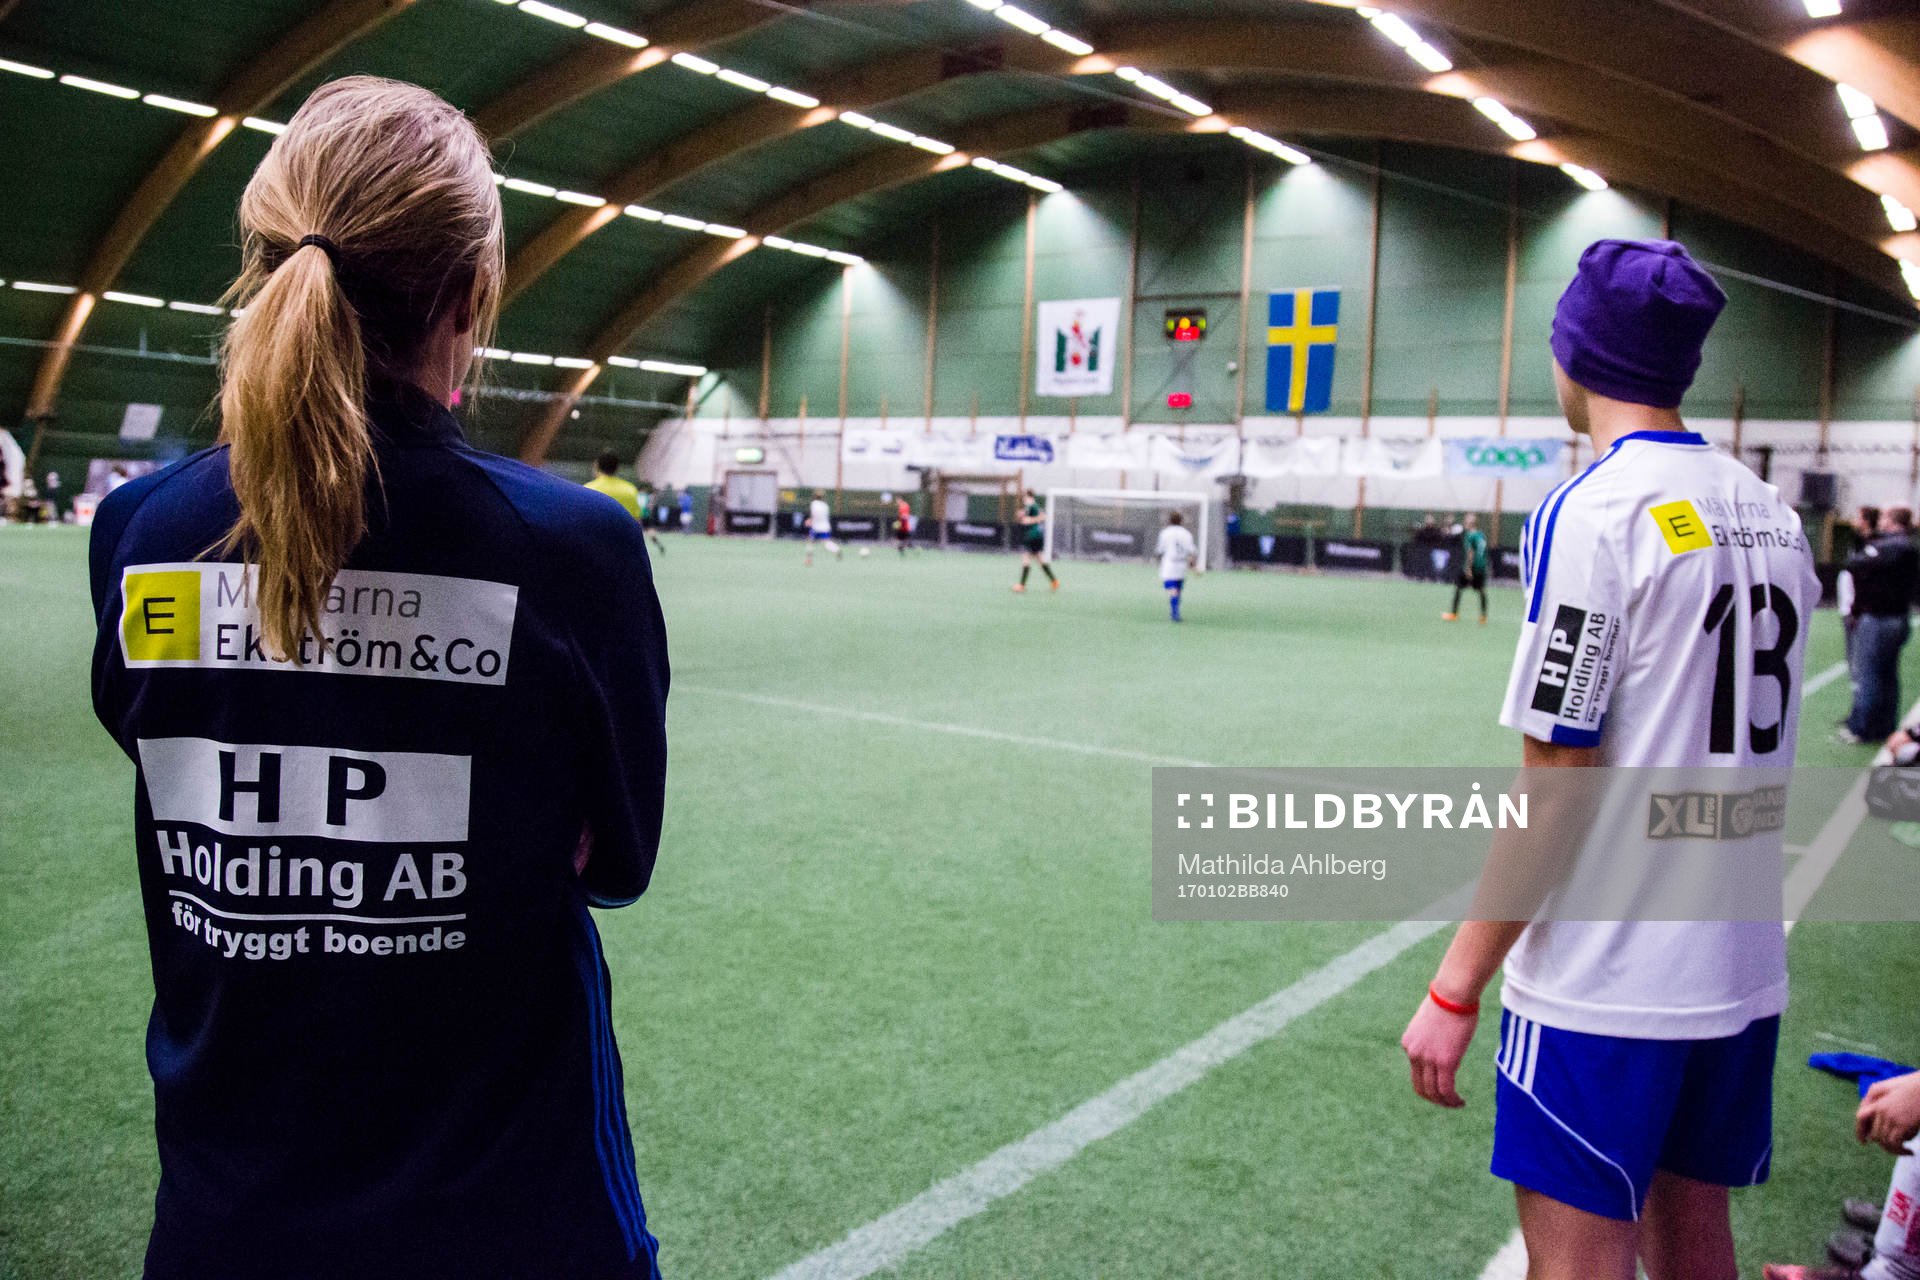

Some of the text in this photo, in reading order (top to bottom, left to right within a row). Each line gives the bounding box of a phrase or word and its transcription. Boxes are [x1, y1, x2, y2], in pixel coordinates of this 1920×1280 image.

[1466, 446, 1546, 471] coop
[217, 571, 422, 618] Marna
[216, 624, 501, 678] Ektröm&Co
[1563, 613, 1606, 720] Holding AB
[1703, 583, 1798, 754] 13
[156, 830, 467, 908] Holding AB
[172, 901, 466, 960] för tryggt boende
